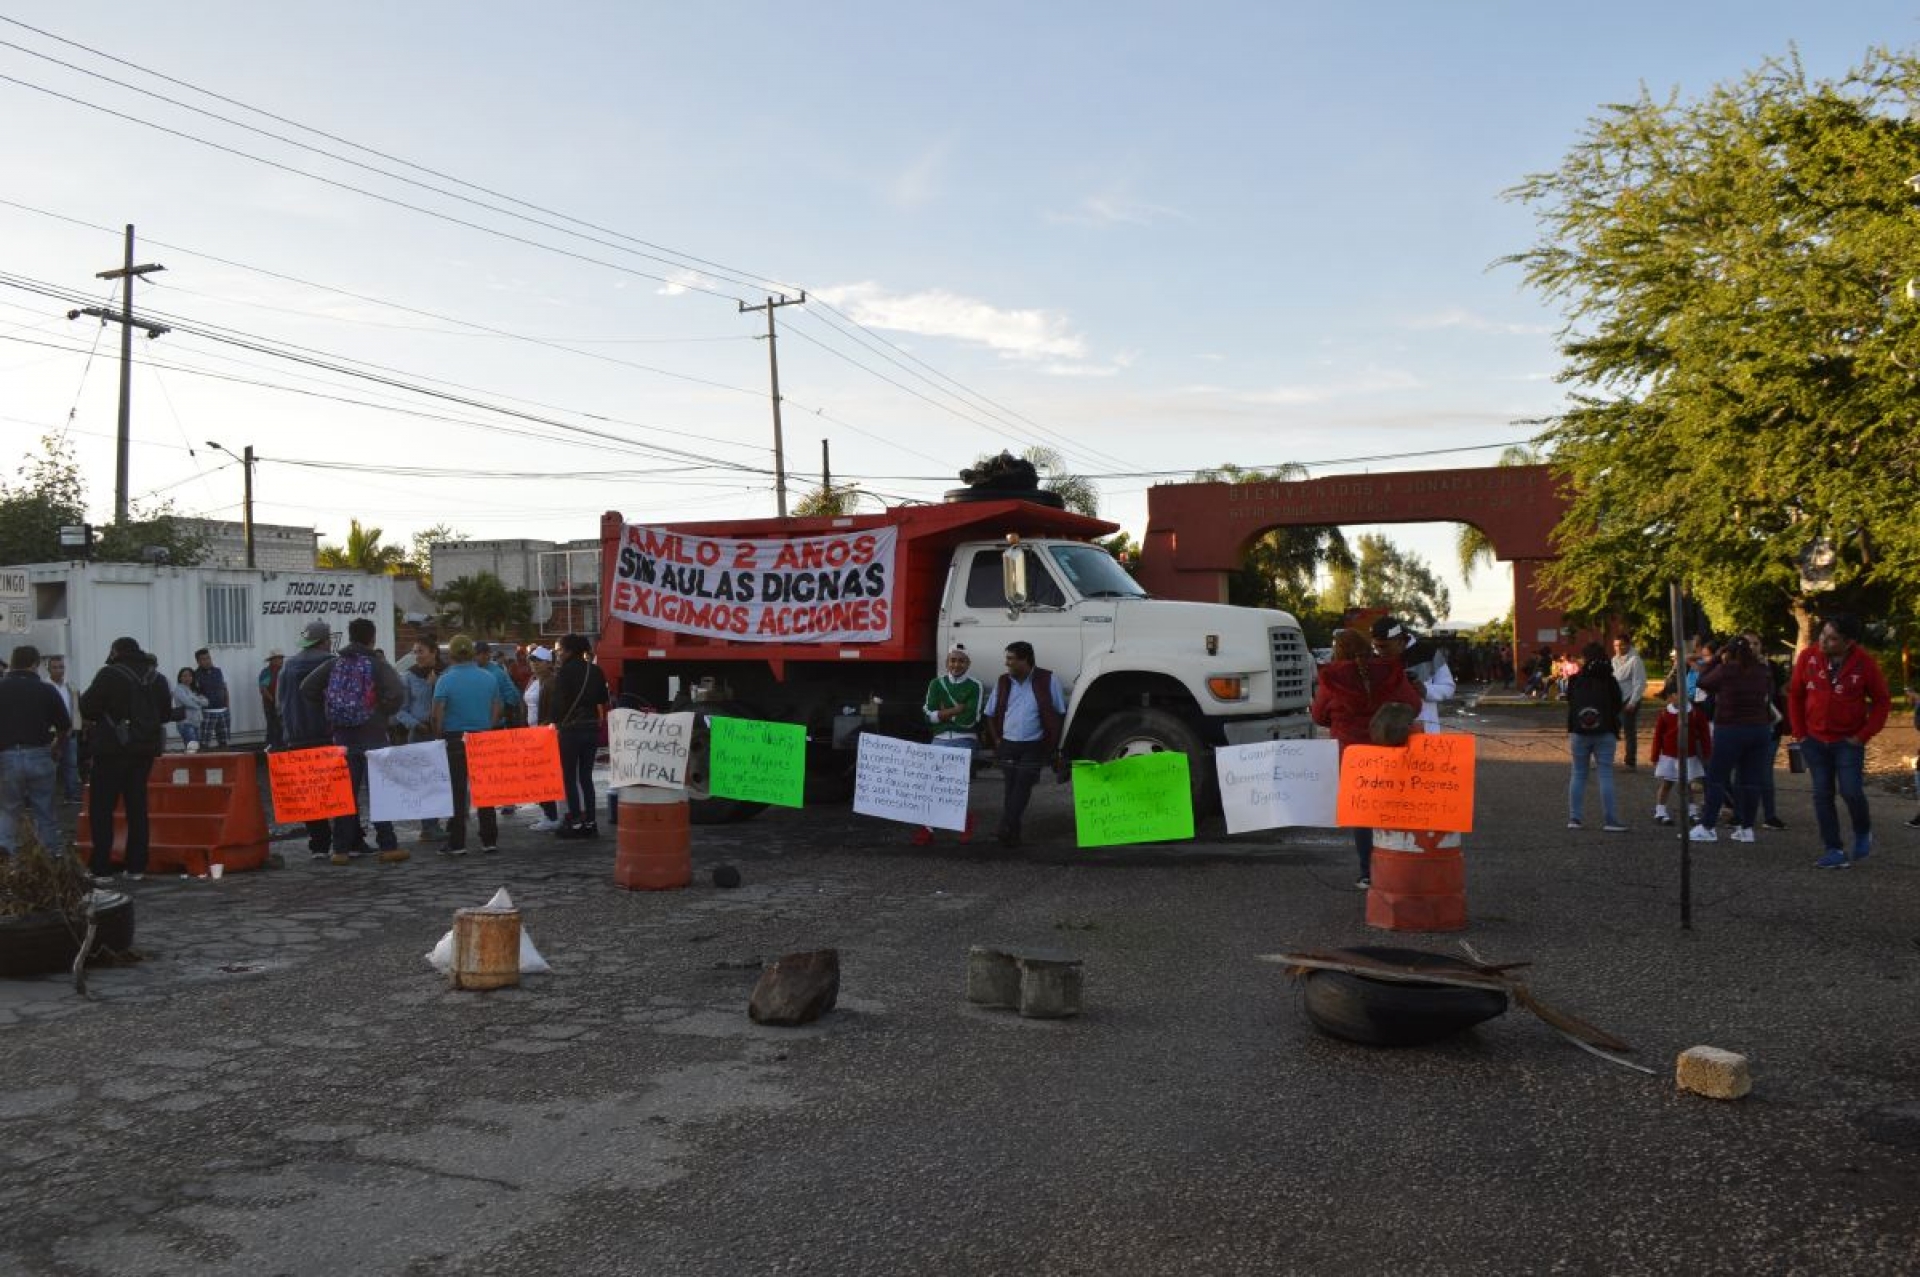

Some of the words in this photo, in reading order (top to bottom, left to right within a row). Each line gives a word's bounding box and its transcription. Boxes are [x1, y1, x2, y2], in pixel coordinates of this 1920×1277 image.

[1229, 484, 1372, 501] BIENVENIDOS
[627, 526, 721, 566] AMLO
[733, 545, 757, 569] 2
[773, 535, 877, 569] AÑOS
[619, 548, 656, 585] SIN
[660, 564, 755, 602] AULAS
[762, 562, 885, 603] DIGNAS
[338, 583, 354, 597] DE
[613, 581, 749, 634] EXIGIMOS
[757, 598, 888, 636] ACCIONES
[626, 713, 682, 737] Falta
[1356, 773, 1395, 789] Orden
[1400, 781, 1405, 792] y
[1411, 775, 1459, 794] Progreso
